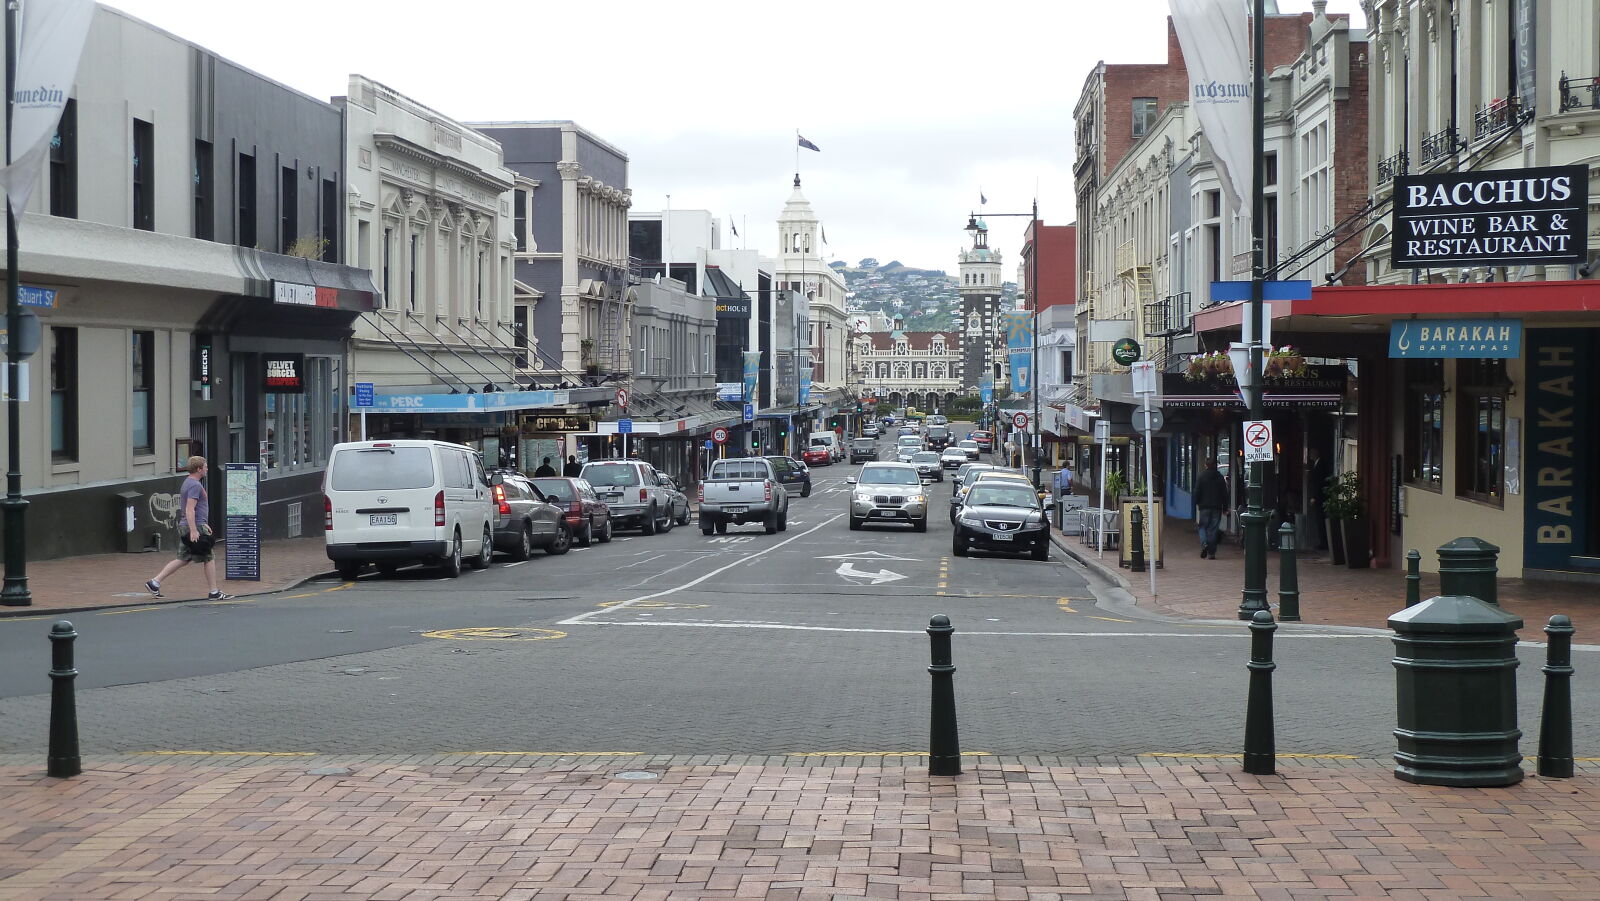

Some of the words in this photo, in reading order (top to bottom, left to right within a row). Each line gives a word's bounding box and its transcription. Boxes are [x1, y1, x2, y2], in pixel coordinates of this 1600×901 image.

[1520, 0, 1530, 68] HUS
[14, 84, 63, 103] unedin
[1406, 176, 1571, 208] BACCHUS
[1409, 217, 1476, 236] WINE
[1487, 215, 1539, 233] BAR
[1550, 213, 1569, 231] &
[1406, 234, 1571, 257] RESTAURANT
[19, 287, 42, 305] Stuart
[45, 290, 53, 306] St
[1420, 326, 1510, 341] BARAKAH
[267, 360, 295, 369] VELVET
[267, 369, 296, 378] BURGER
[1537, 347, 1574, 544] BARAKAH
[371, 515, 396, 525] EAA156
